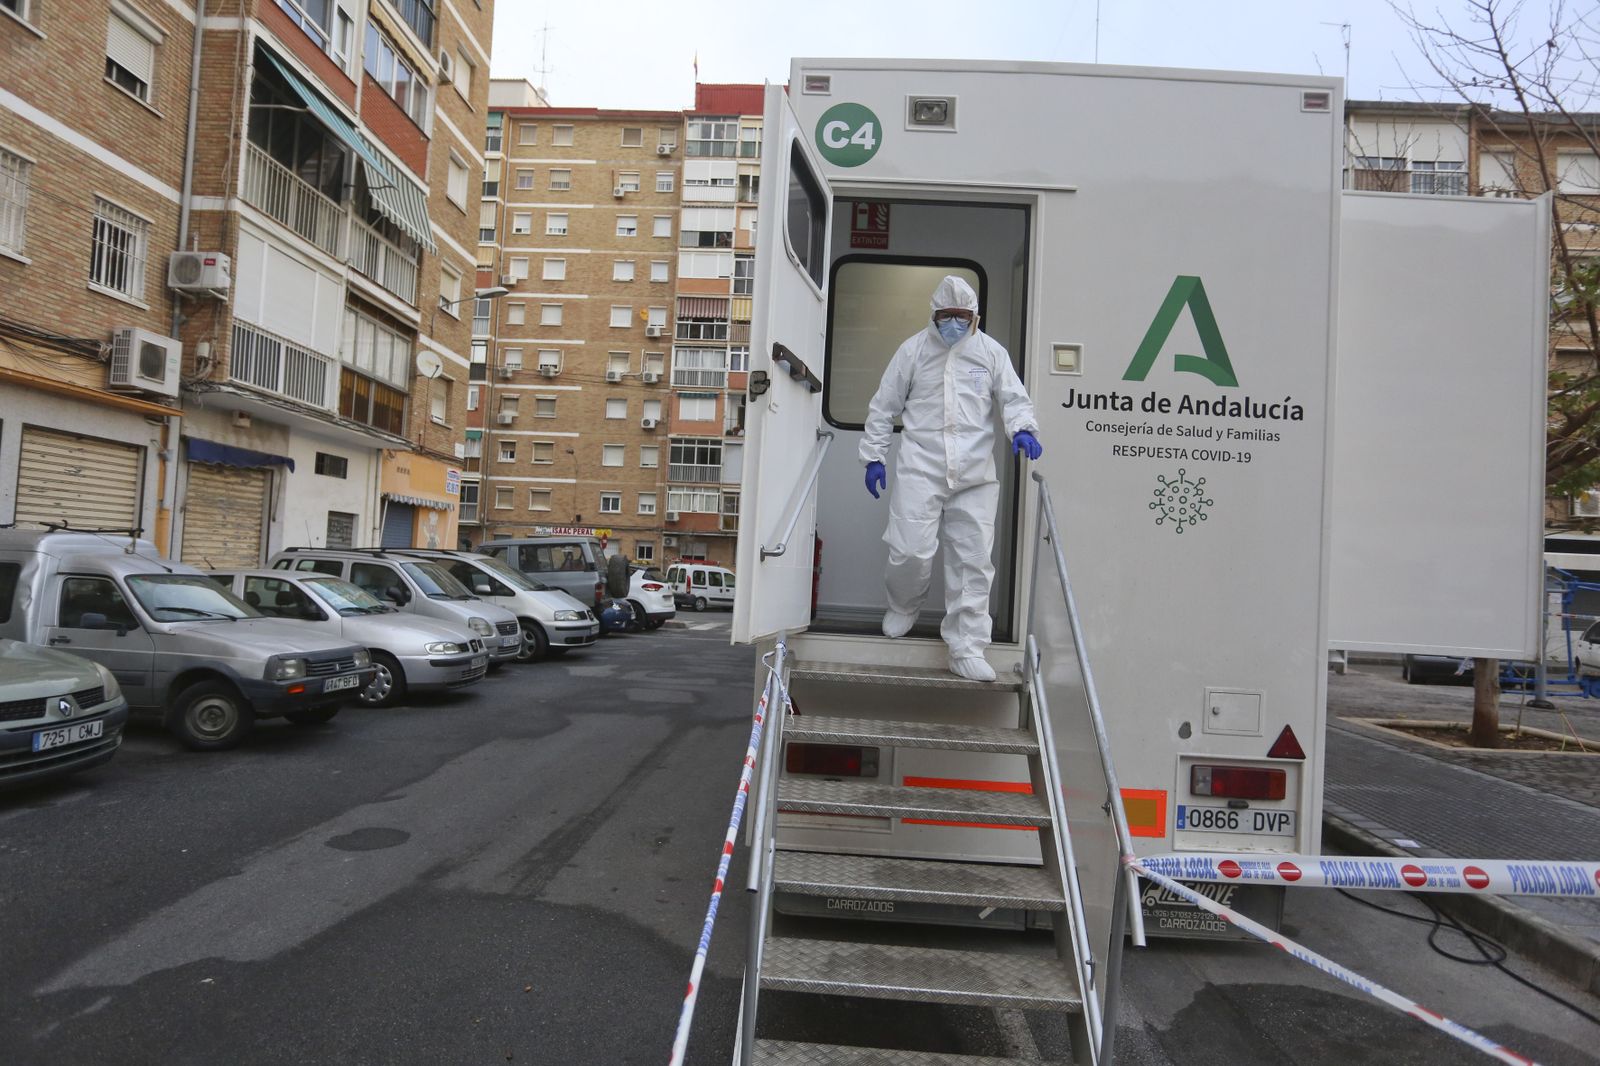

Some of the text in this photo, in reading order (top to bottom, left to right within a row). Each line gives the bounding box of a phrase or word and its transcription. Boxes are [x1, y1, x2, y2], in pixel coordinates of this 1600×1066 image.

[822, 120, 876, 150] C4
[1061, 388, 1304, 421] Junta de Andalucía
[1085, 420, 1281, 442] Consejería de Salud y Familias
[1112, 444, 1252, 463] RESPUESTA COVID-19
[552, 526, 572, 536] ISAAC
[572, 527, 594, 536] PERAL
[42, 721, 102, 748] 7251 CMJ
[1189, 808, 1239, 830] 0866
[1253, 811, 1291, 832] DVP
[1184, 857, 1218, 880] LOCAL
[1320, 861, 1401, 888] POLICIA LOCAL
[1506, 864, 1595, 896] POLICIA LOCAL
[827, 898, 895, 913] CARROZADOS
[1159, 917, 1227, 932] CARROZADOS
